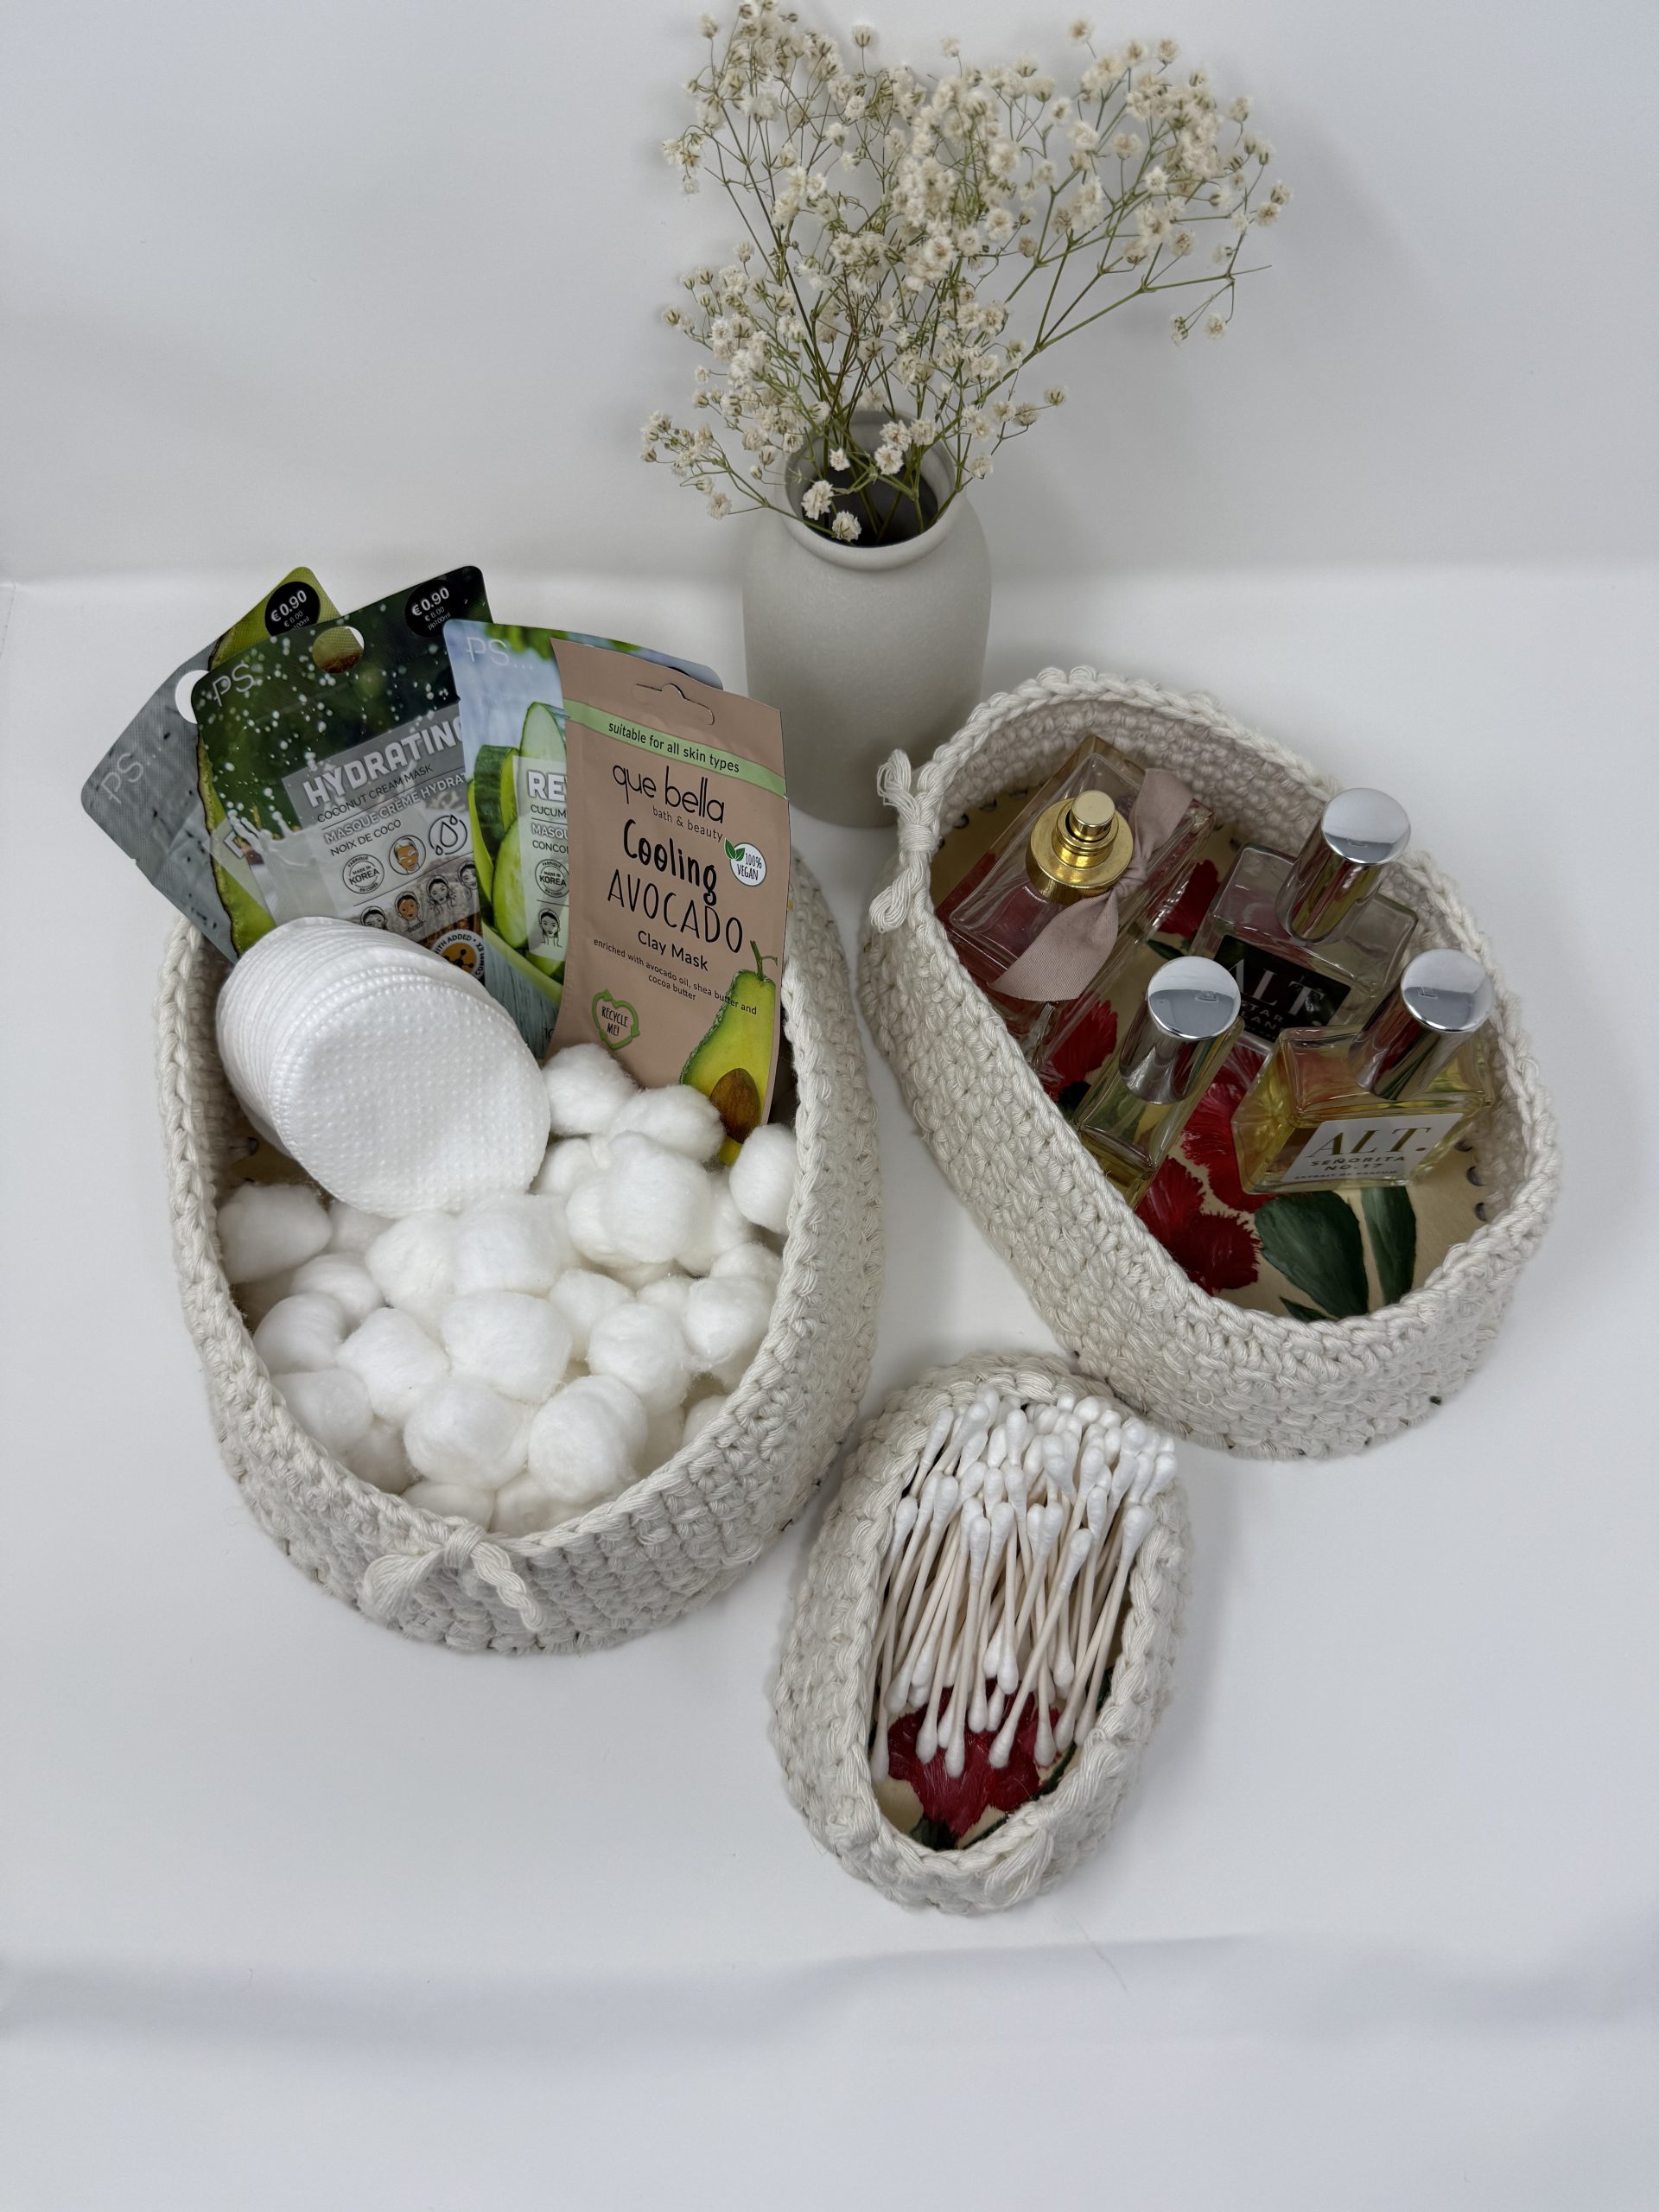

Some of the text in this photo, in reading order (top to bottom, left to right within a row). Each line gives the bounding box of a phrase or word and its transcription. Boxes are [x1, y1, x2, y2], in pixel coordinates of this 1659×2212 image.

[608, 721, 741, 773] suitable for all skin types
[316, 764, 434, 823] COCONUT CREAM MASK
[527, 771, 567, 802] RE
[612, 764, 726, 824] que bella
[324, 811, 379, 844] MASQUE
[330, 819, 402, 857] NOIX DE COCO
[652, 805, 724, 843] bath & beauty
[532, 840, 569, 855] CONCO
[623, 818, 717, 906] Cooling
[745, 852, 763, 869] 100%
[349, 868, 381, 886] KOREA
[539, 874, 567, 887] KOREA
[736, 863, 760, 881] VEGAN
[607, 868, 744, 954] AVOCADO
[434, 933, 472, 955] ITH ADDED
[637, 930, 709, 972] Clay Mask
[594, 938, 757, 1015] enriched with avocado oil, shea butter and
[648, 974, 697, 1002] cocoa butter
[601, 1005, 630, 1028] RECYCLE
[606, 1021, 620, 1038] ME!
[1306, 1127, 1432, 1159] ALT.
